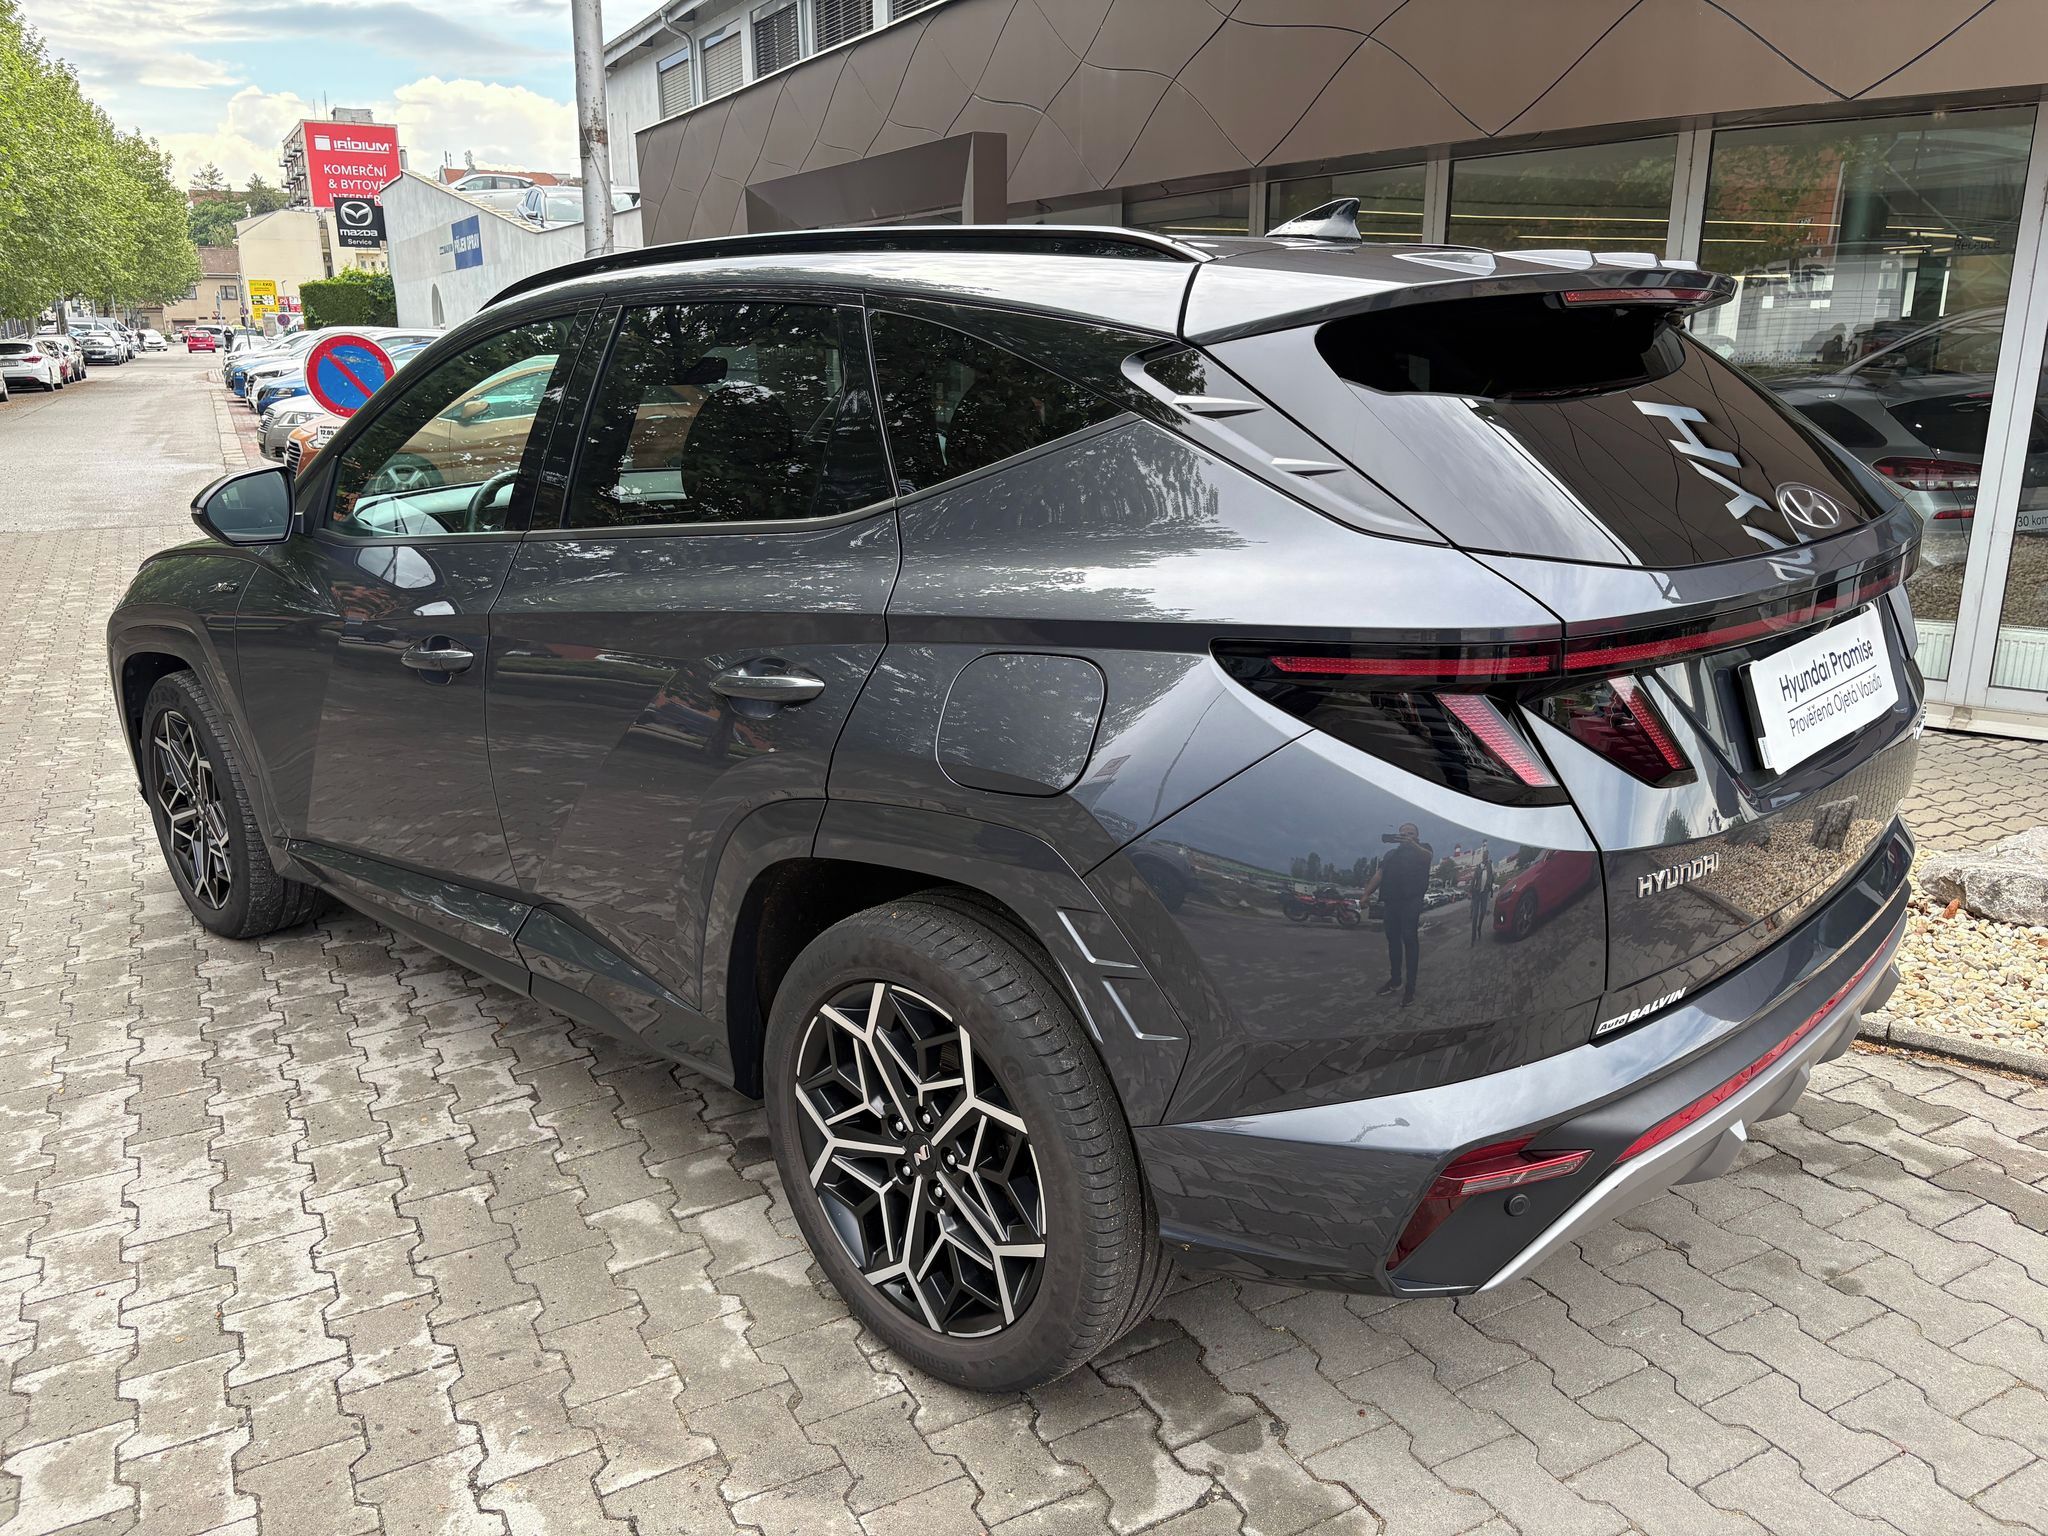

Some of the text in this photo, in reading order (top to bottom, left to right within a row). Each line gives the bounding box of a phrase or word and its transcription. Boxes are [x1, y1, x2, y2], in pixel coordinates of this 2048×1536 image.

[324, 164, 388, 177] KOMERČNÍ
[328, 178, 386, 191] & BYTOVÉ
[1779, 637, 1874, 702] Hyundai Promise
[1789, 673, 1882, 737] Prověřená Ojetá Vozidla
[1637, 851, 1719, 898] HYUNDAI
[1598, 986, 1687, 1032] Auto BALVIN
